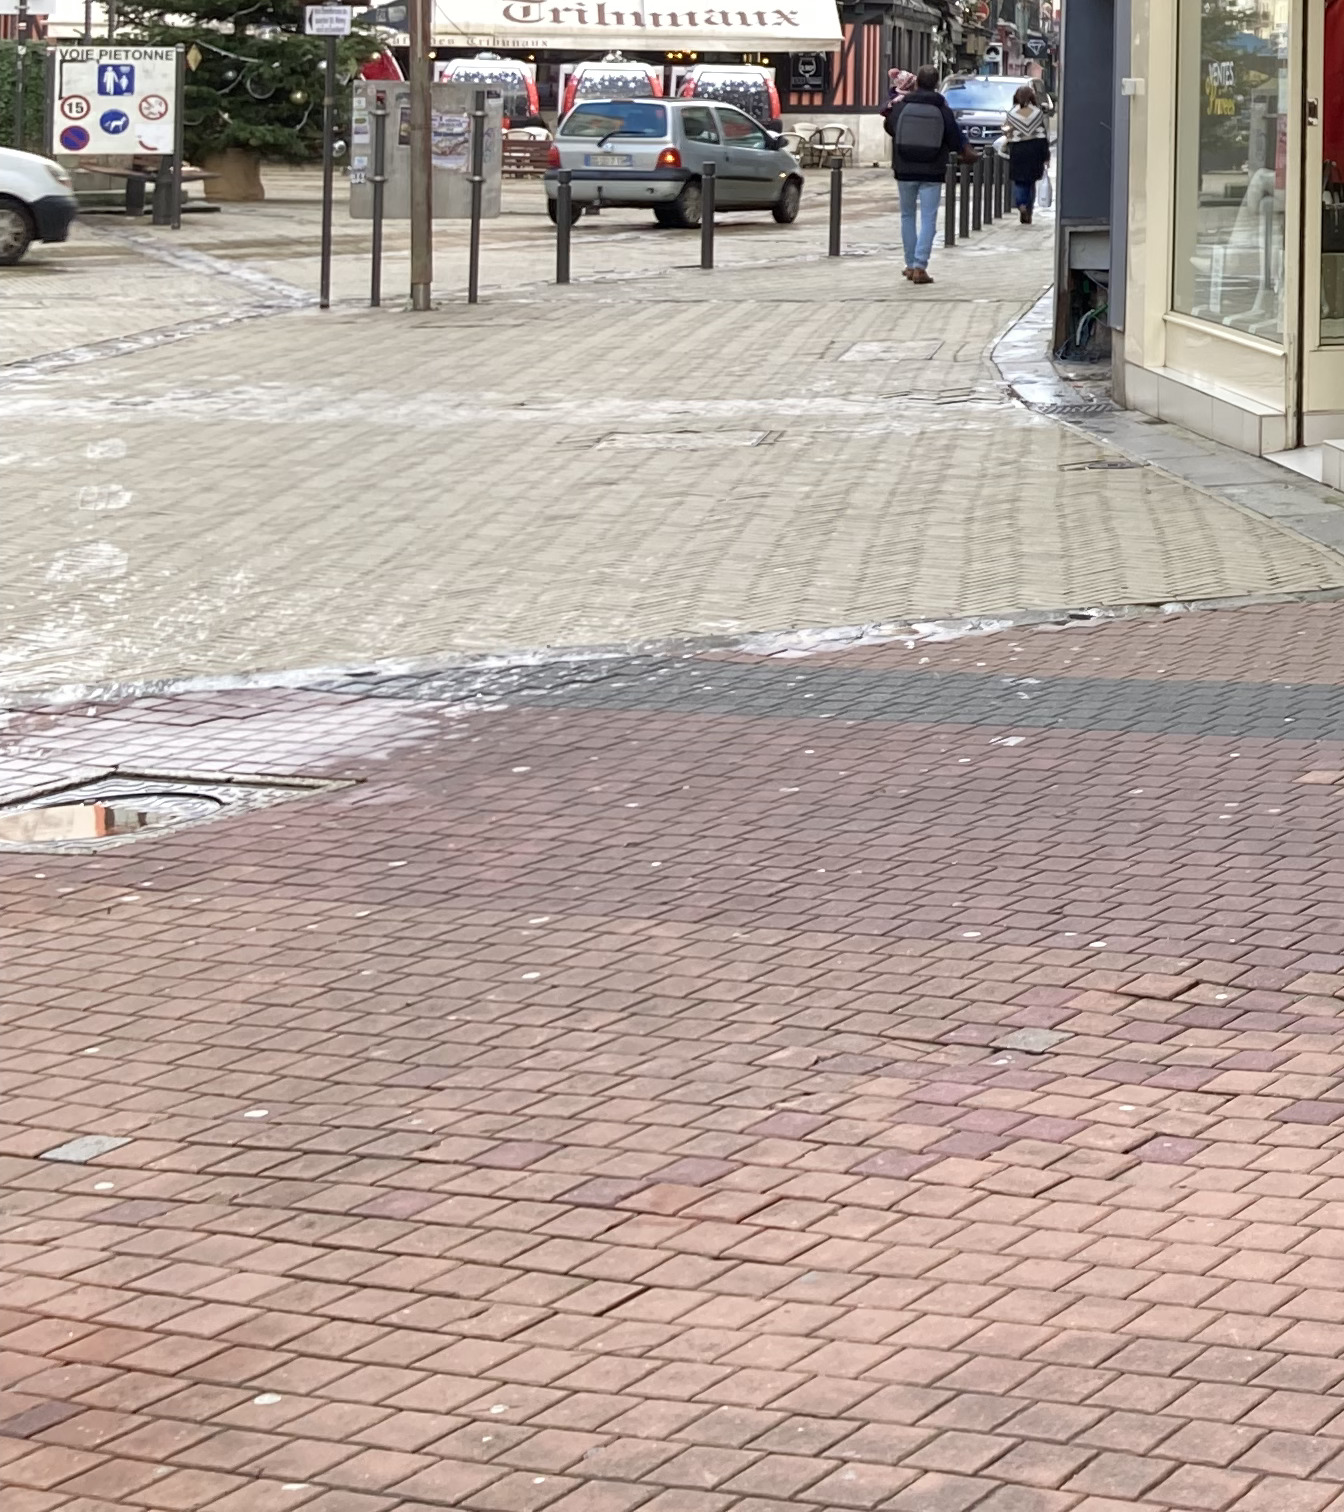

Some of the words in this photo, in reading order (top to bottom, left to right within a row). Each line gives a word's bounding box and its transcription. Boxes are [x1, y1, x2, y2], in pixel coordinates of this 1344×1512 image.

[60, 49, 94, 60] VOIE
[99, 49, 174, 61] PIETONNE
[67, 102, 84, 114] 15
